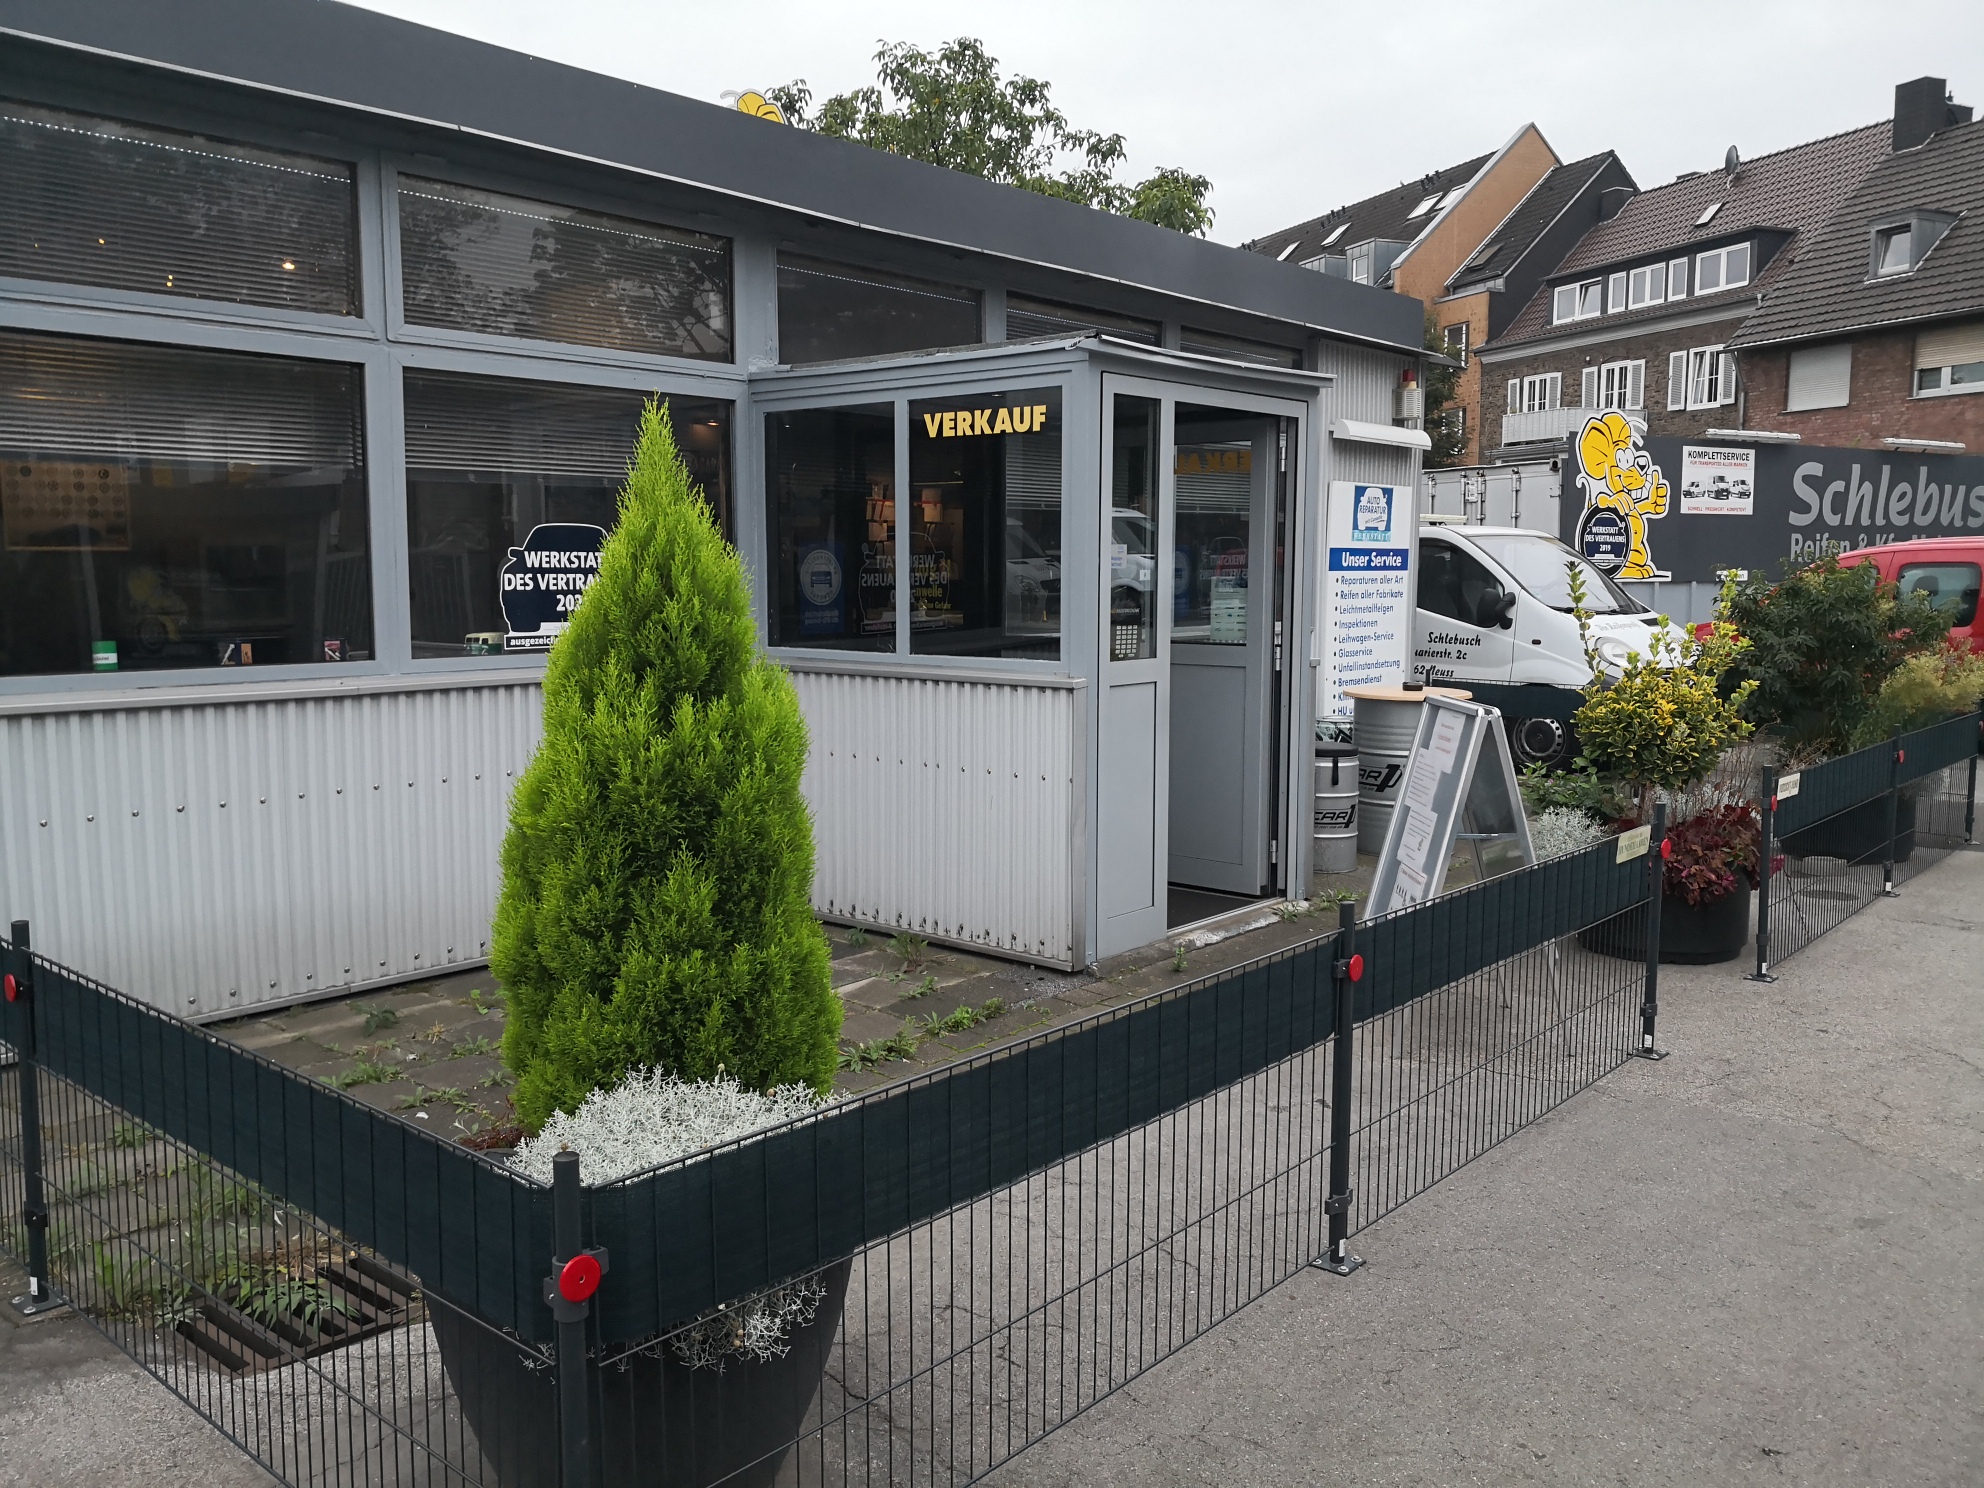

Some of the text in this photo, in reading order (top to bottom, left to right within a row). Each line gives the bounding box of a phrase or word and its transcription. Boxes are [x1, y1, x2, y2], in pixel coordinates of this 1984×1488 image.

[923, 405, 1047, 438] VERKAUF
[1687, 450, 1750, 461] KOMPLETTSERVICE
[1788, 461, 1984, 528] Schlebus
[1367, 497, 1380, 505] AUTO
[1359, 505, 1387, 514] REPARATUR
[1592, 526, 1619, 534] WERKSTATT
[1600, 544, 1611, 552] 2019
[1790, 532, 1850, 563] Reifn
[524, 551, 605, 568] WERKSTAT
[1342, 552, 1402, 567] Unser Service
[504, 573, 597, 590] DES VERTRA
[1340, 575, 1404, 587] Reparaturen aller Art
[1340, 589, 1404, 600] Reifen aller Fabrikate
[1340, 603, 1394, 614] Leichtmetallfelgen
[1338, 618, 1378, 631] Inspektionen
[1338, 632, 1394, 644] Leihwagen-Service
[1428, 632, 1481, 646] Schlebusch
[1338, 647, 1372, 658] Glasservice
[1456, 650, 1467, 660] 2c
[1338, 659, 1400, 673] Unfallinstandsetzung
[1414, 664, 1454, 678] 62 Neuss
[1338, 674, 1382, 687] Bremsendienst
[1338, 706, 1348, 716] HU
